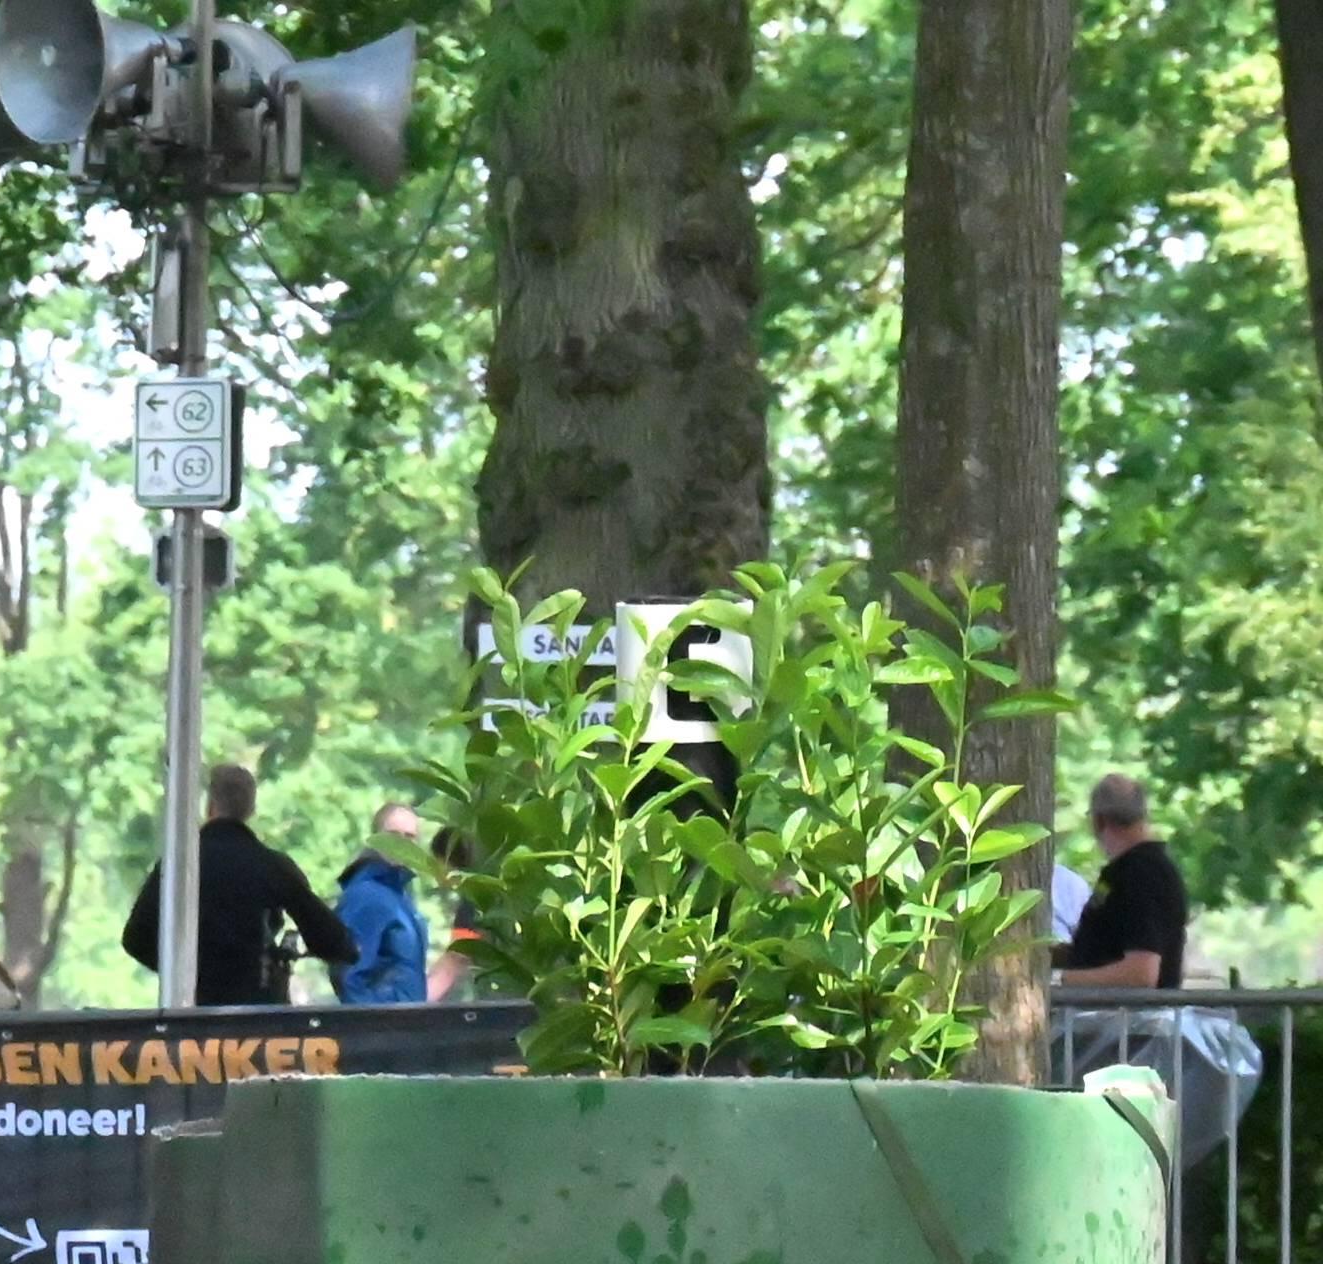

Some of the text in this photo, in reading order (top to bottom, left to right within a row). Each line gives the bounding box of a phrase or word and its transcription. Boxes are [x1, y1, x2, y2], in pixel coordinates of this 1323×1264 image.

[182, 402, 208, 421] 62
[182, 457, 207, 477] 63
[91, 1037, 341, 1086] KANKER
